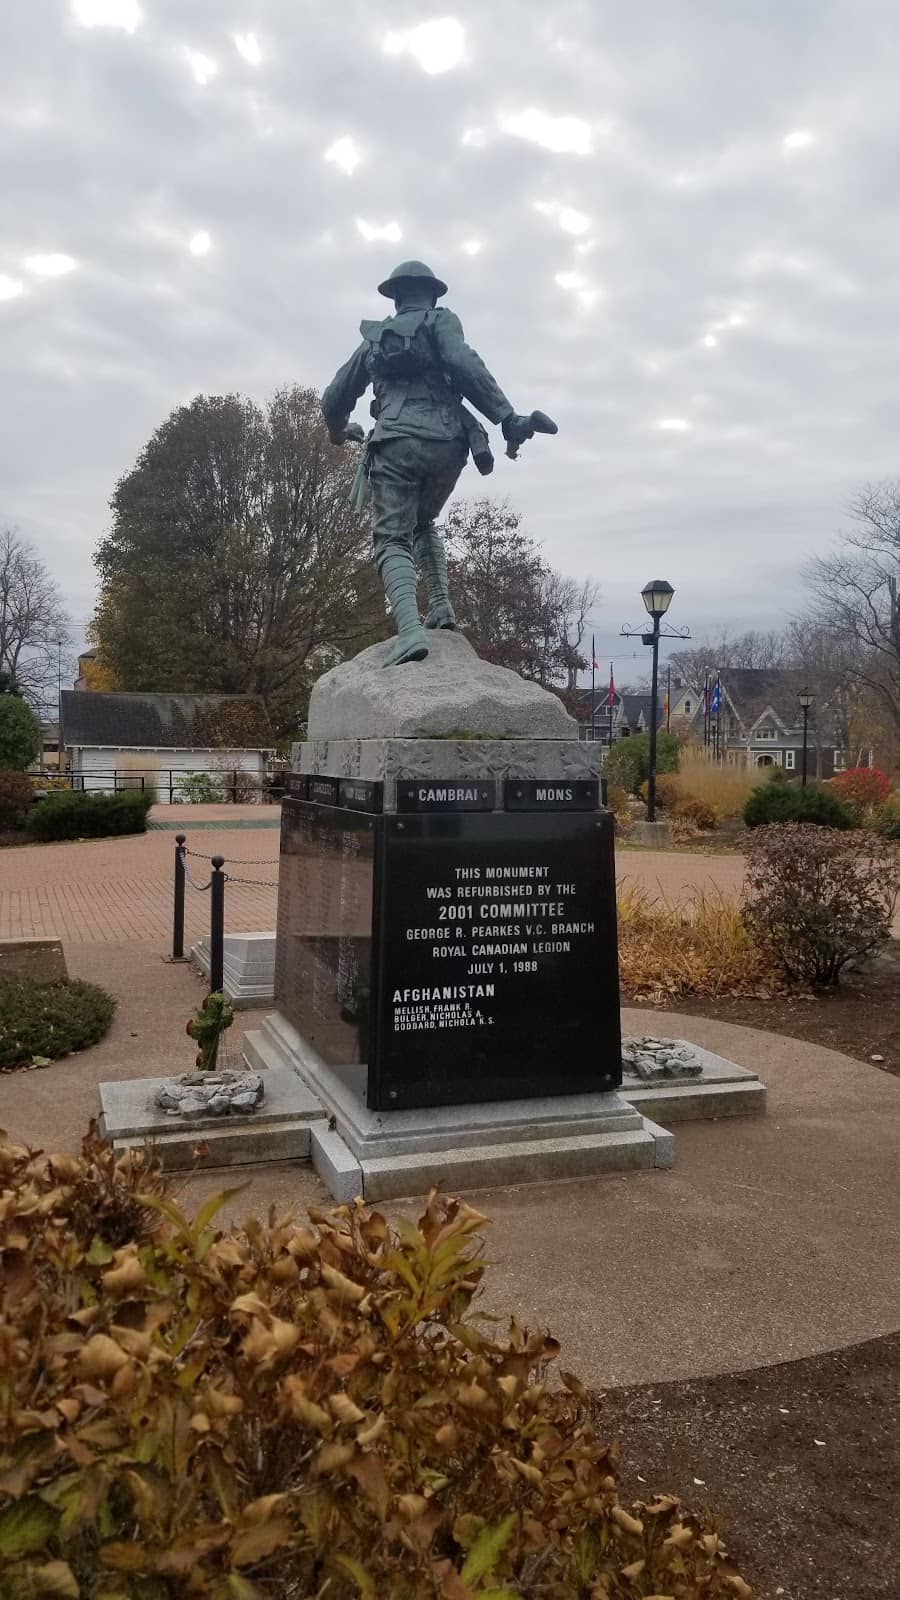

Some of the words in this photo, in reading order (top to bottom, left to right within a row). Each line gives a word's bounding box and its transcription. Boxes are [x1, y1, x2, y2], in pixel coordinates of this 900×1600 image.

[418, 788, 478, 802] CAMBRAI
[536, 788, 573, 801] MONS
[455, 867, 480, 880] THIS
[486, 866, 550, 879] MONUMENT
[426, 887, 452, 898] WAS
[457, 885, 532, 898] REFURBISHED
[538, 884, 551, 896] BY
[556, 884, 576, 895] THE
[439, 905, 473, 920] 2001
[480, 902, 565, 918] COMMITTEE
[406, 928, 450, 940] GEORGE
[456, 928, 466, 938] R.
[472, 925, 520, 938] PEARKES
[526, 925, 546, 936] V.C.
[552, 922, 595, 934] BRANCH
[432, 946, 466, 958] ROYAL
[472, 943, 528, 956] CANADIAN
[533, 941, 570, 954] LEGION
[468, 963, 494, 974] JULY
[513, 961, 538, 972] 1988
[392, 984, 495, 1002] AFGHANISTAN
[434, 1003, 461, 1013] FRANK
[430, 1010, 472, 1021] NICHOLAS
[394, 1020, 437, 1031] GODDARD,
[438, 1017, 476, 1028] NICHOLA
